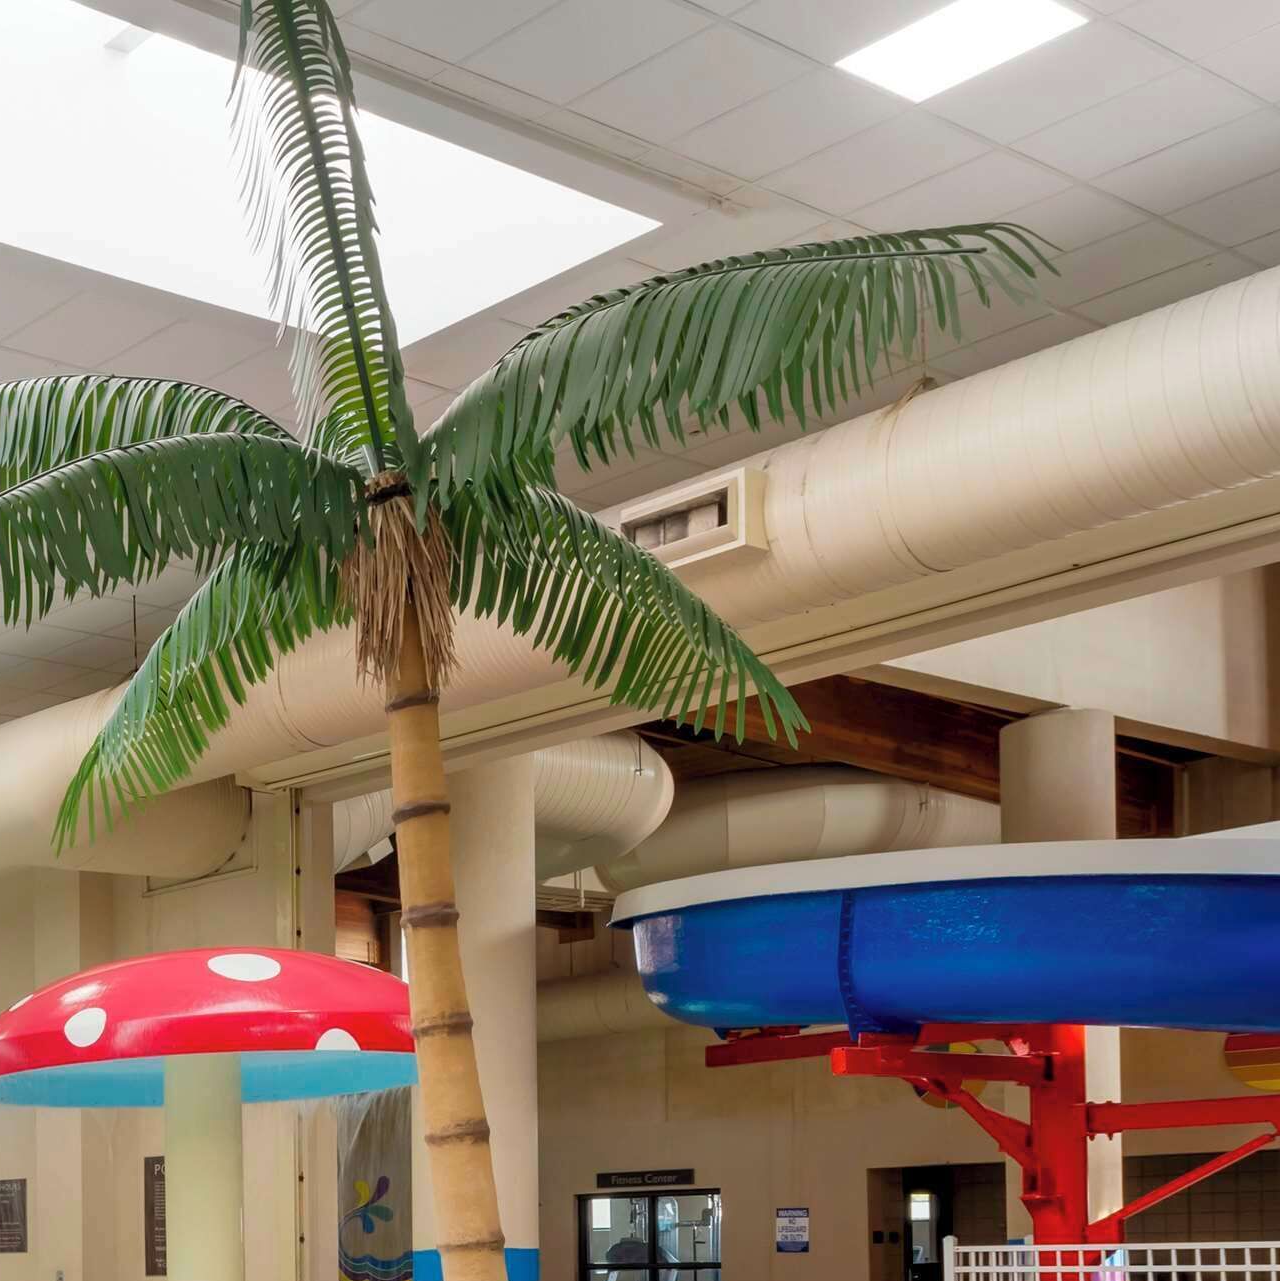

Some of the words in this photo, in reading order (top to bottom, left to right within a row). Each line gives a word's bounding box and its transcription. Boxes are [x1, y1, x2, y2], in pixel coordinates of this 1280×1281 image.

[611, 1175, 643, 1185] Fitness
[644, 1173, 678, 1184] Center
[778, 1209, 808, 1217] WARNING
